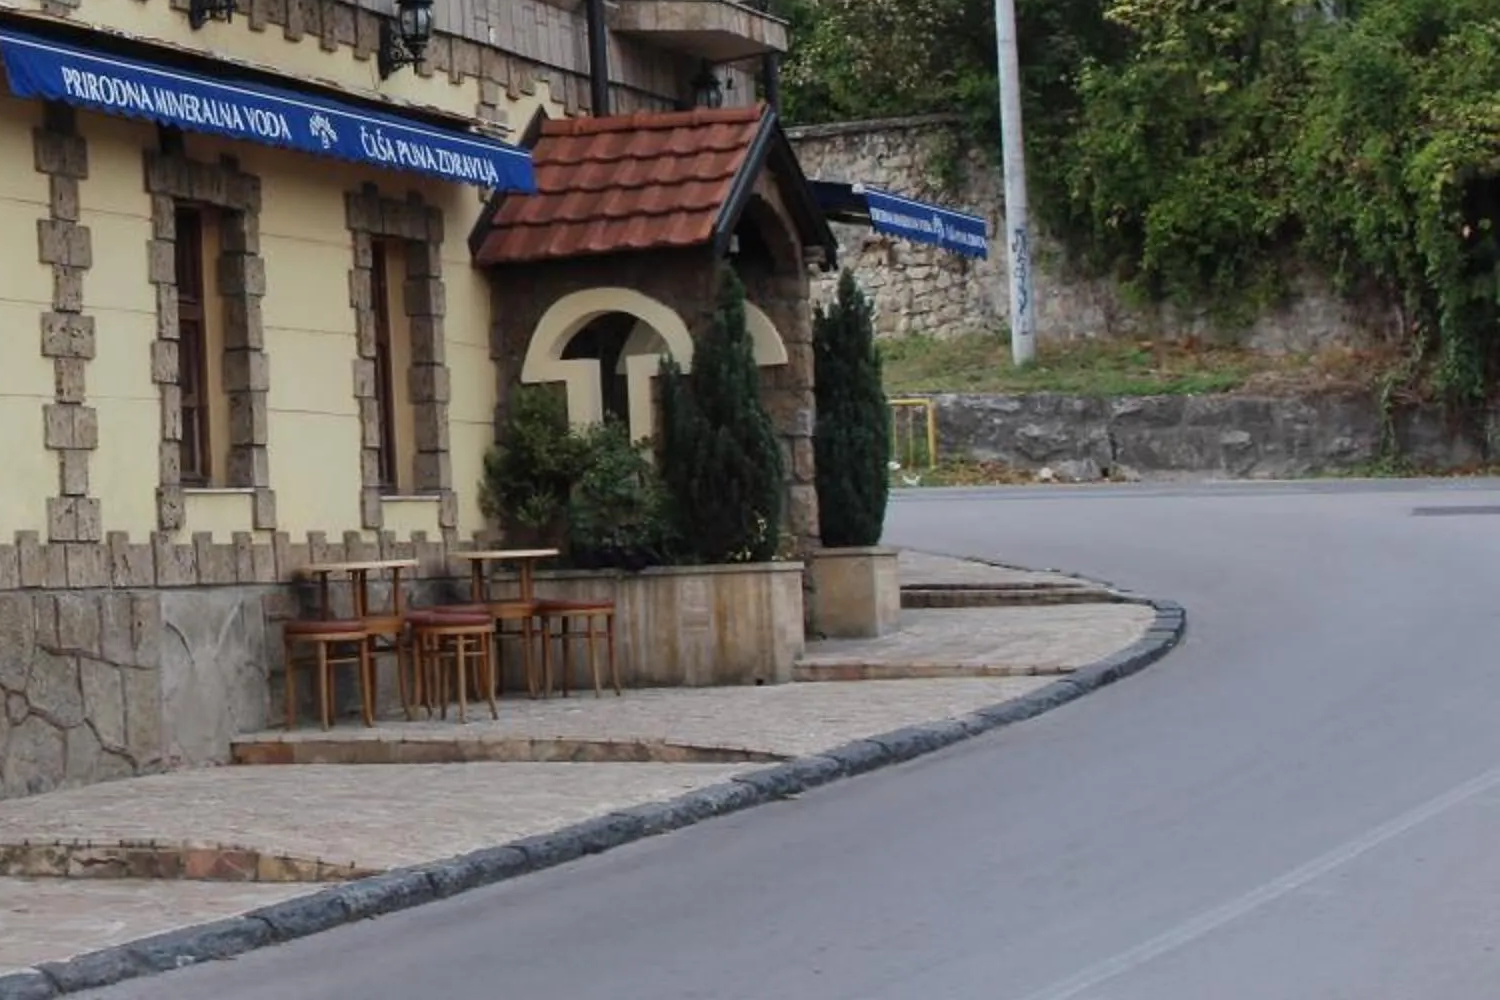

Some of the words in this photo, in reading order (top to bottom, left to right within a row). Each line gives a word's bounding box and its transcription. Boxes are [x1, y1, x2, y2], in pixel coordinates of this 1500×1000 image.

[61, 66, 154, 112] PRIRODNA
[152, 87, 245, 131] MINERALNA
[243, 106, 293, 140] VODA
[397, 140, 437, 172] PUNA
[436, 149, 499, 185] ZDRAVLJA
